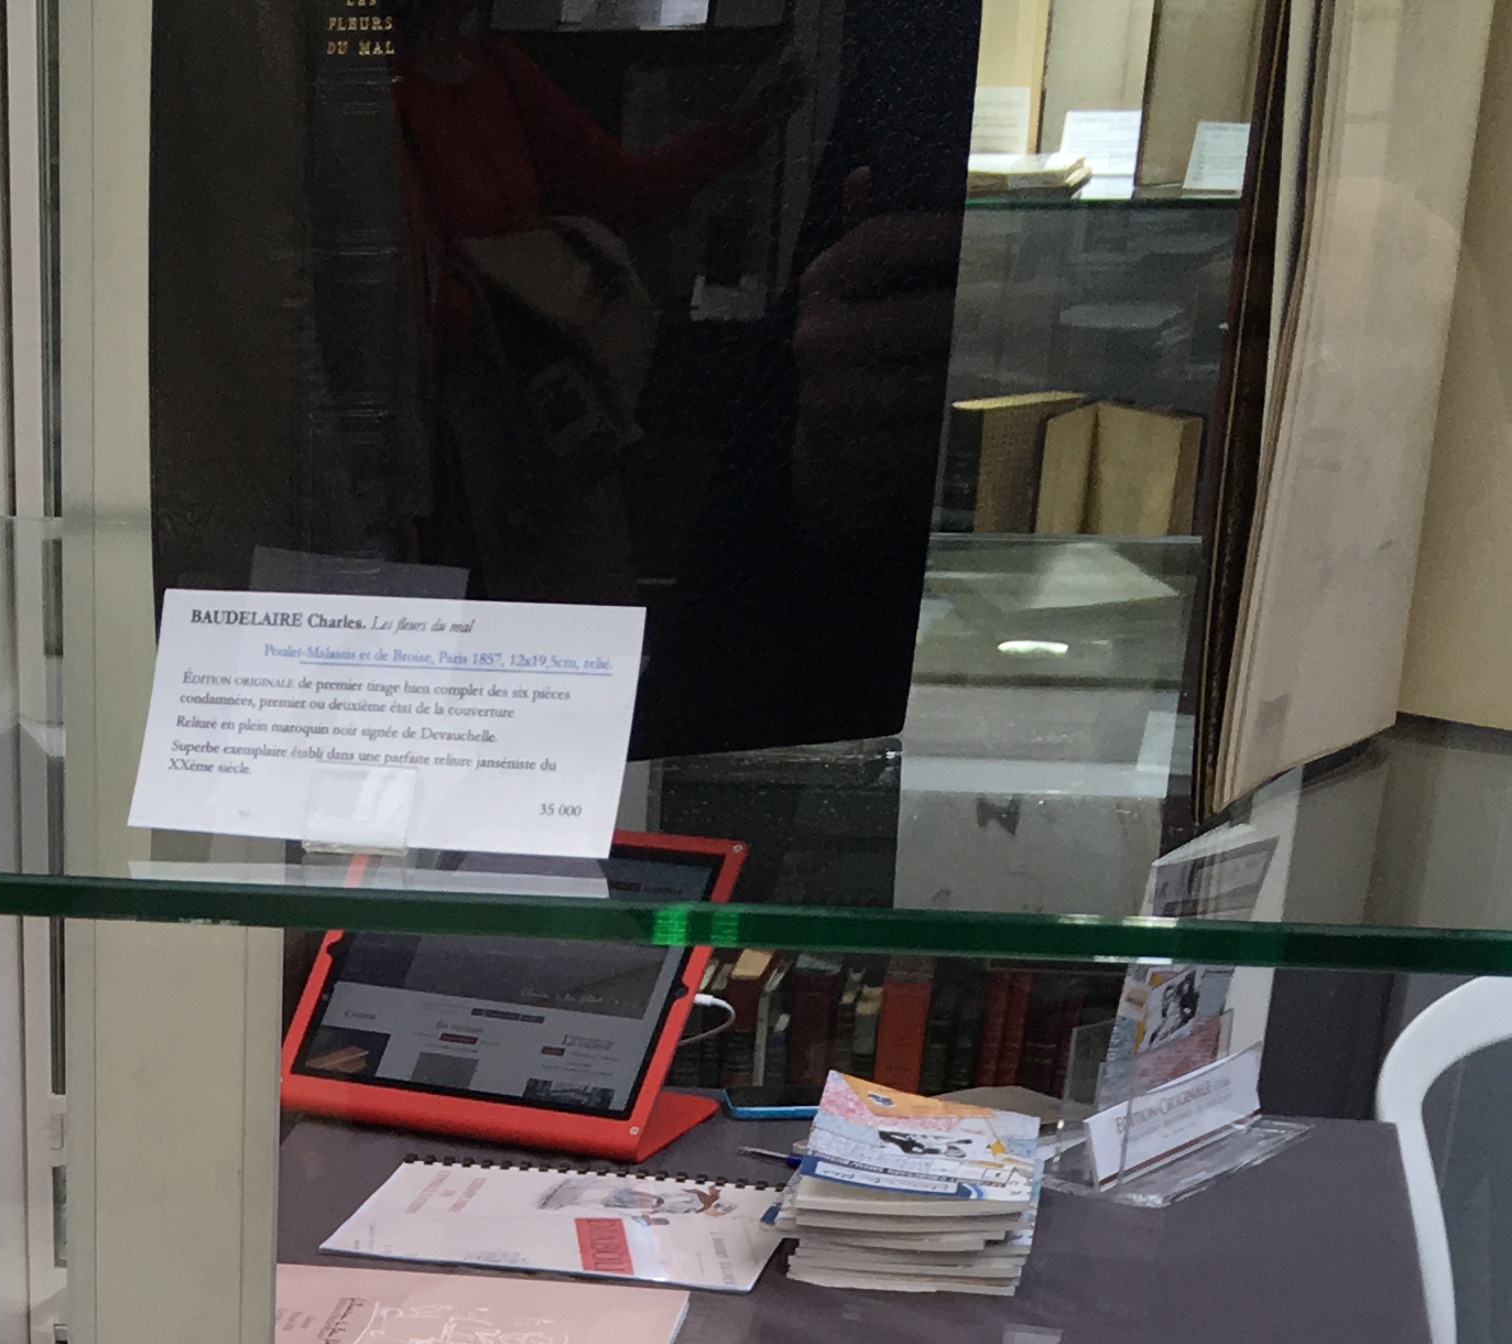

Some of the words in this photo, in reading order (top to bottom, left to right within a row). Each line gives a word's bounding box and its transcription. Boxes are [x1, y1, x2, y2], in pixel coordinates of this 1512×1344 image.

[327, 16, 394, 32] FLEURS
[327, 41, 349, 56] DU
[358, 40, 396, 56] MAL
[190, 608, 304, 628] BAUDELAIRE
[307, 612, 367, 630] Charles.
[370, 615, 394, 631] Les
[395, 616, 426, 632] fleurs
[430, 618, 447, 632] du
[449, 618, 476, 634] mal
[297, 675, 314, 690] de
[314, 678, 364, 694] premier
[366, 679, 401, 697] tirage
[403, 680, 431, 695] bien
[433, 682, 485, 701] complet
[486, 683, 509, 698] des
[530, 686, 571, 704] pièces
[538, 802, 555, 816] 35
[557, 803, 583, 818] 000
